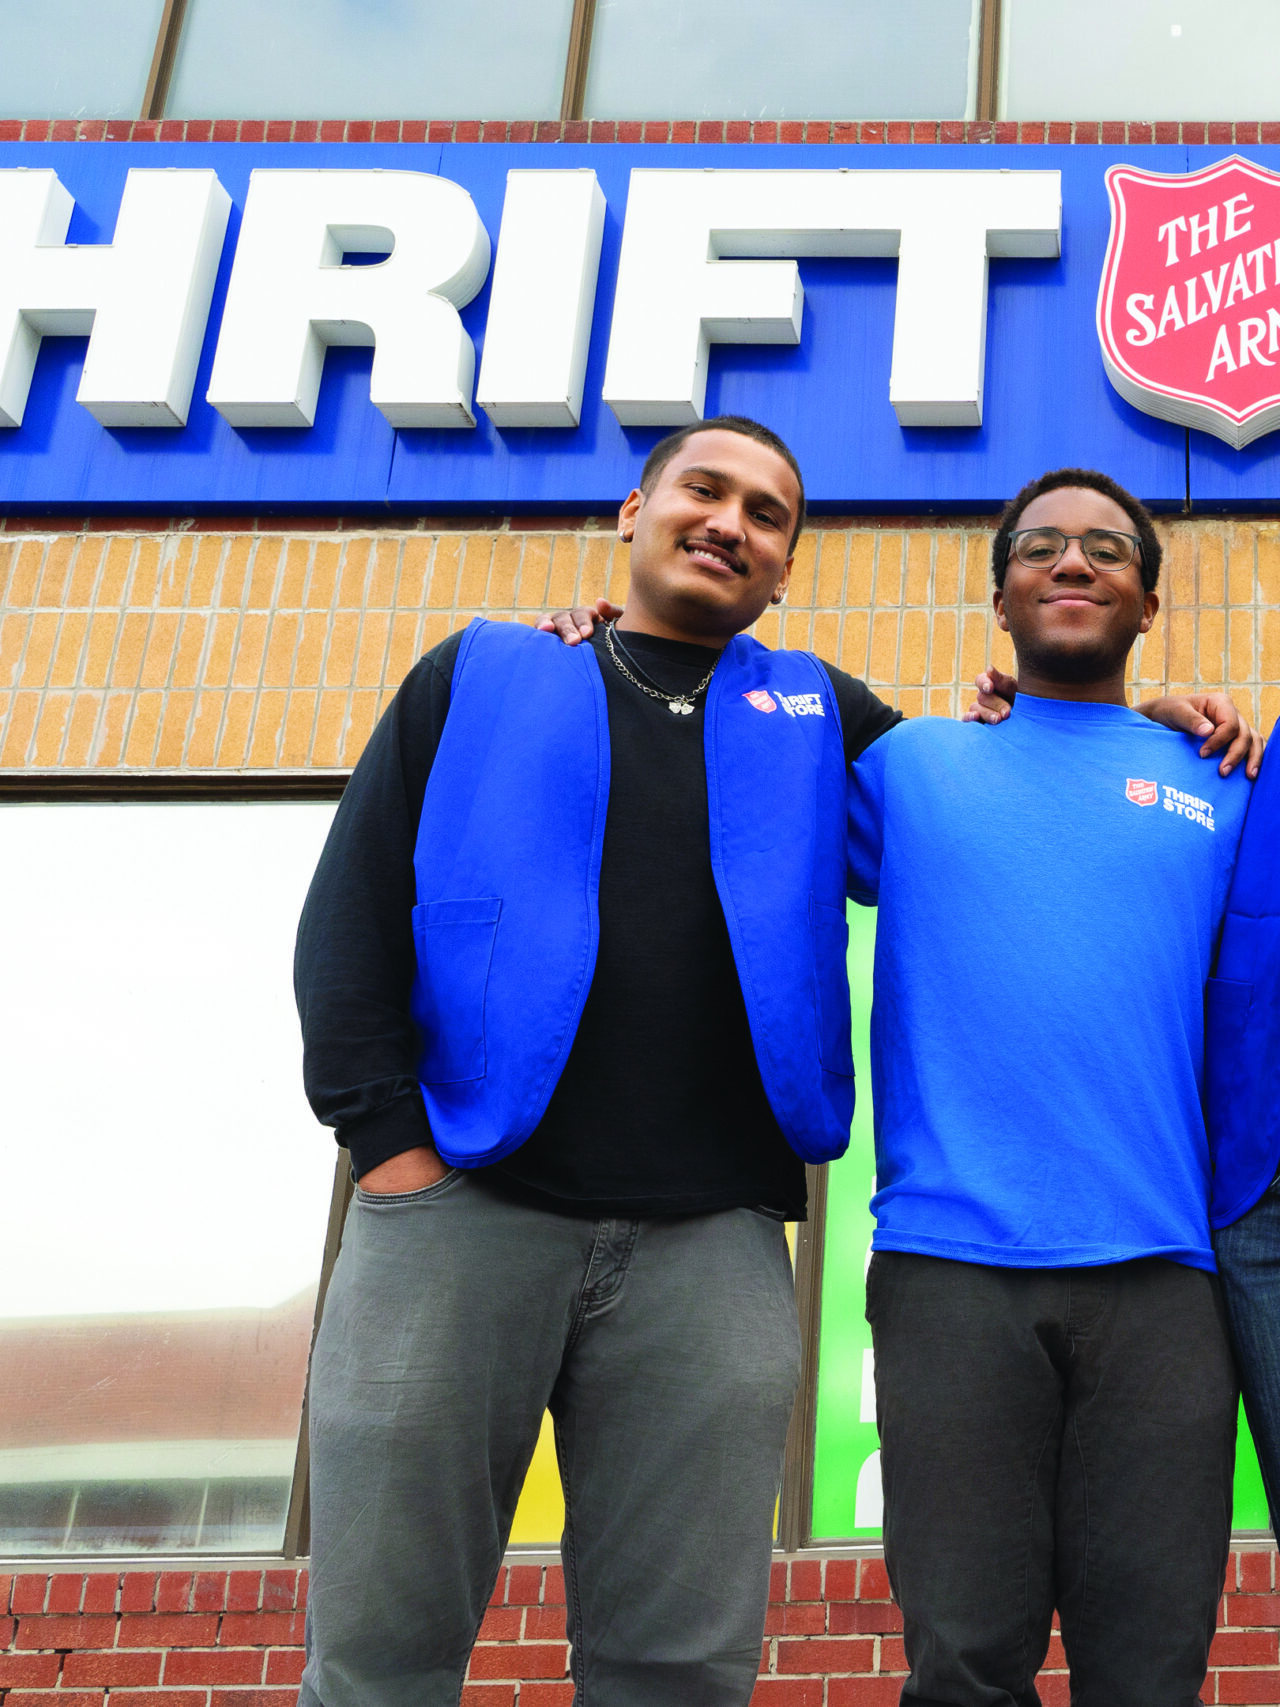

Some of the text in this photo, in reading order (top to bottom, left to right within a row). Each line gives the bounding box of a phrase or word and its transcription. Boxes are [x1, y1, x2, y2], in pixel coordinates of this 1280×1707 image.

[1157, 192, 1255, 268] THE
[782, 702, 825, 717] TORE
[1162, 785, 1215, 817] THRIFT
[1163, 798, 1216, 831] STORE
